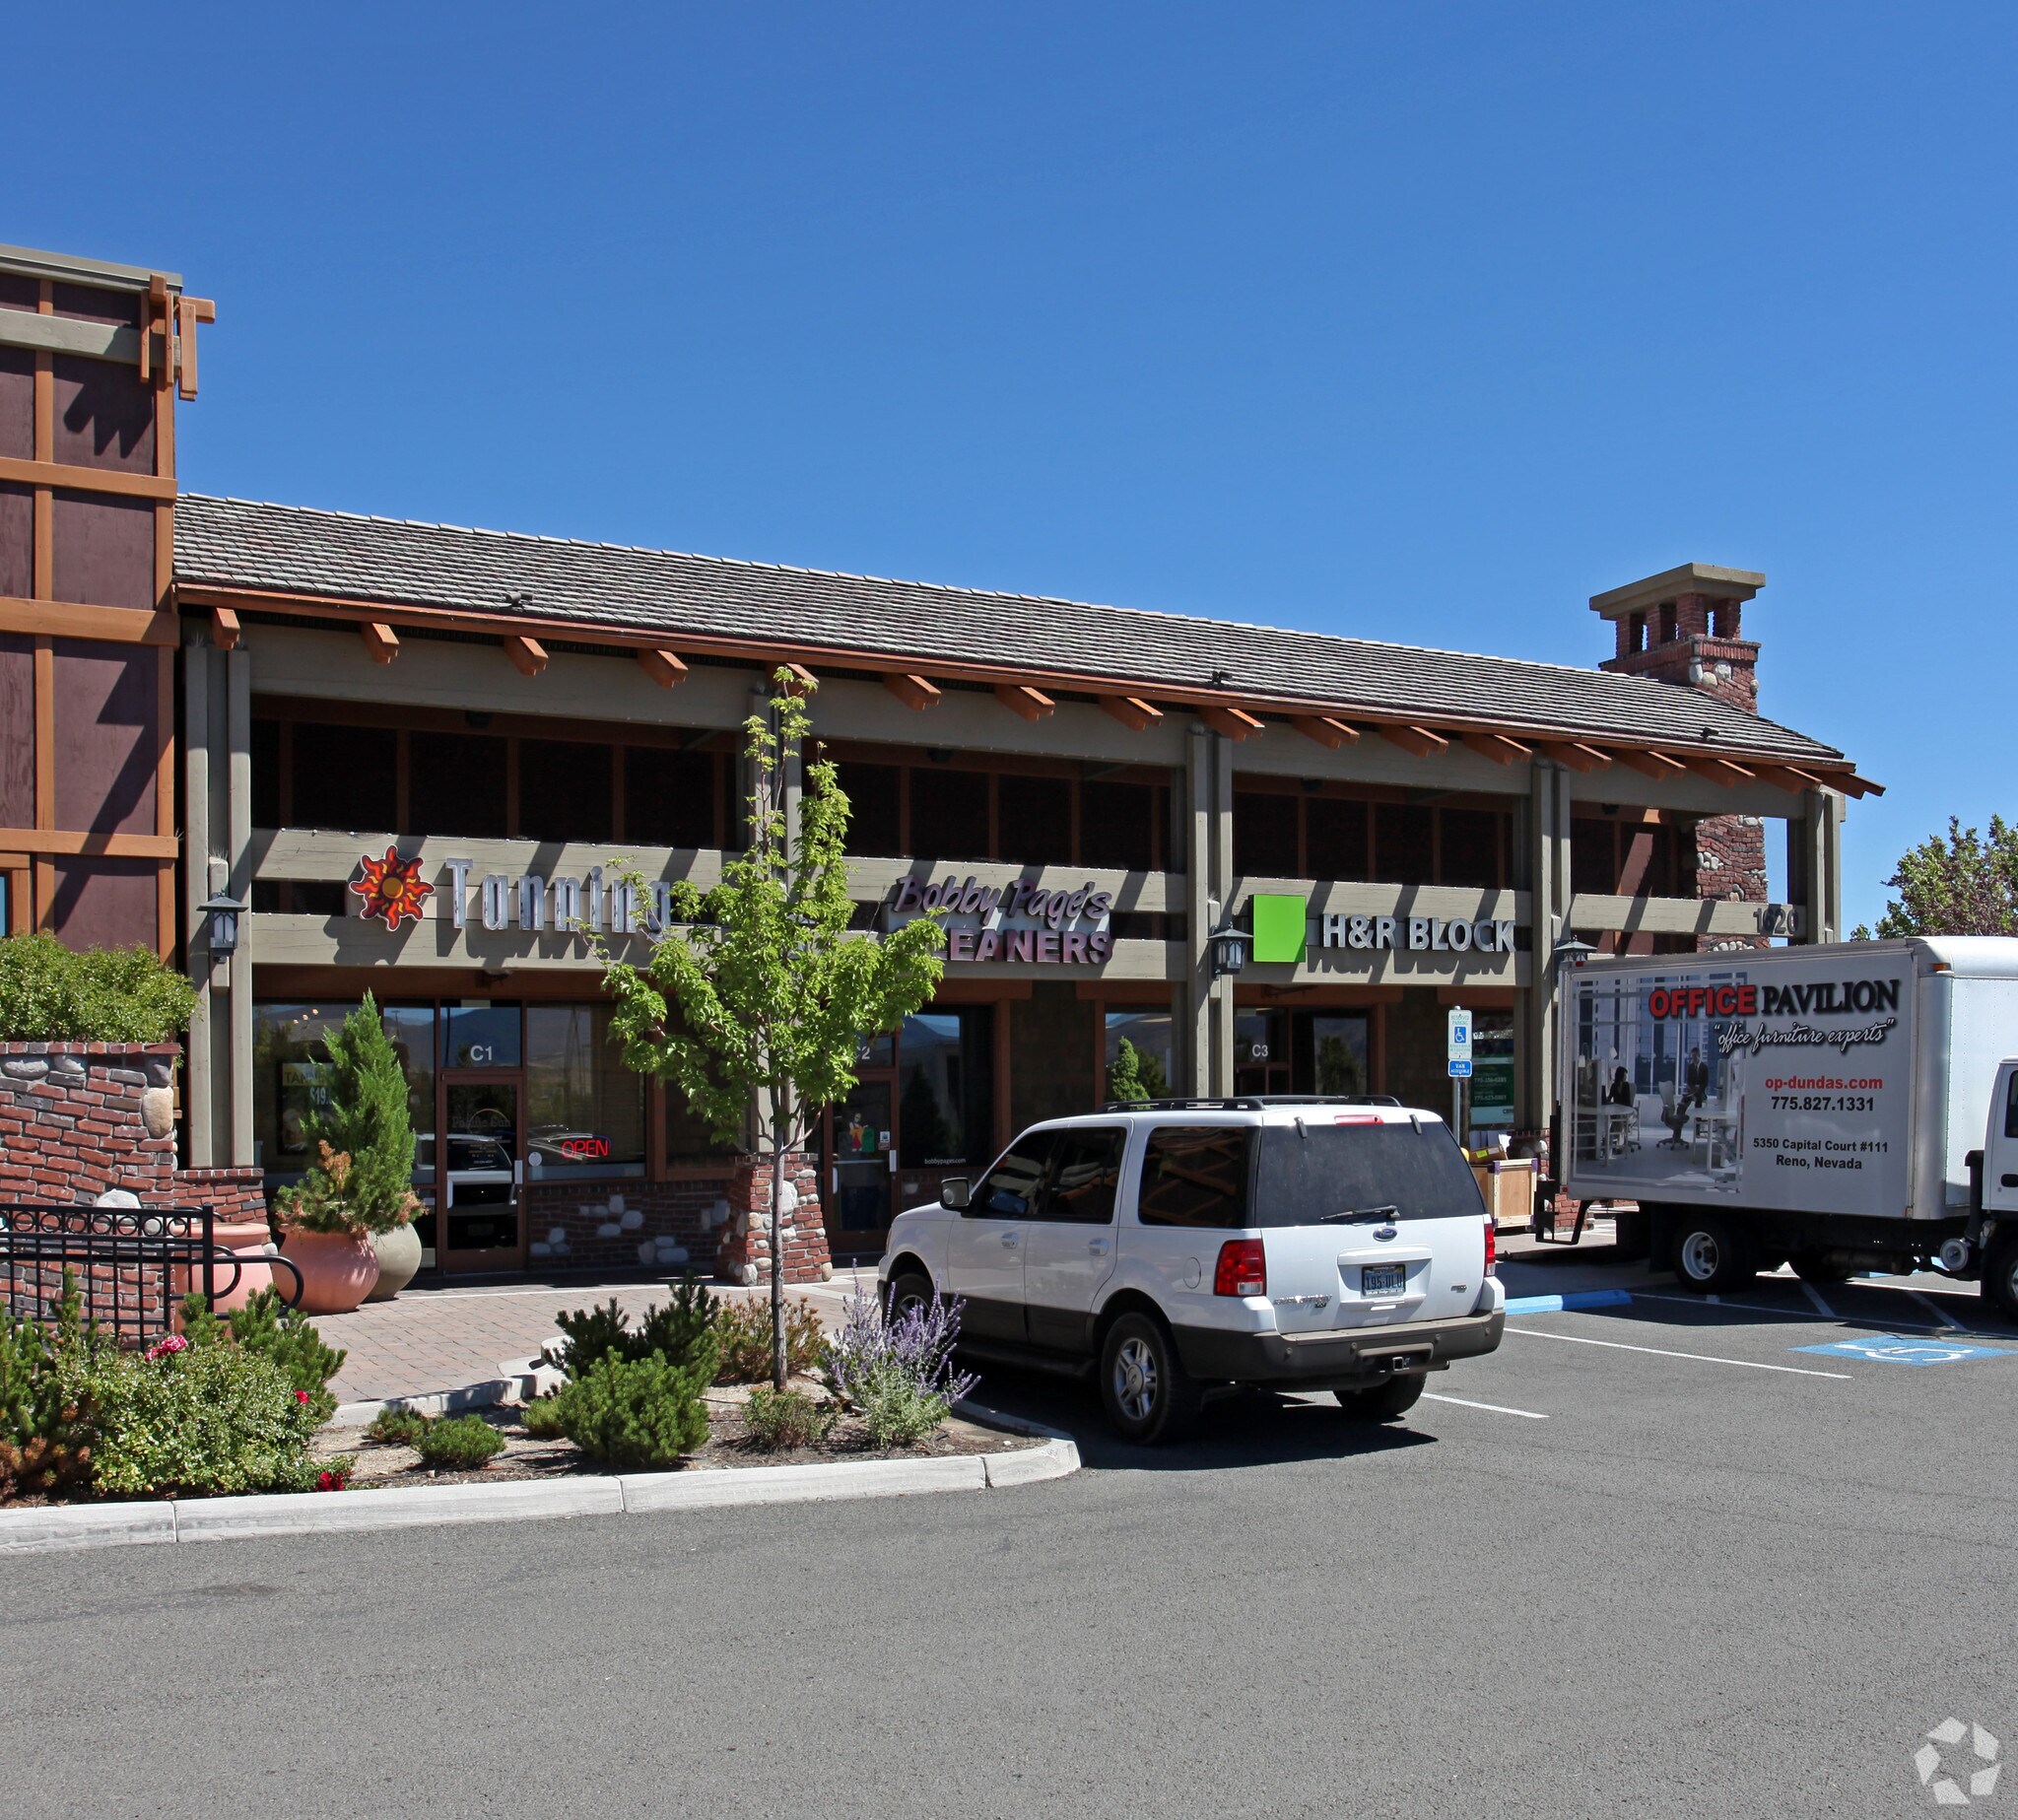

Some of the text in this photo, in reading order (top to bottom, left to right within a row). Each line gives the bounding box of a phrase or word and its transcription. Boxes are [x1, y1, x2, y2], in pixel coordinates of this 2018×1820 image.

[445, 857, 671, 942] Tanning
[893, 875, 1113, 930] Bobby Page's
[1753, 908, 1798, 934] 1620
[1321, 913, 1516, 952] H&R BLOCK
[932, 927, 1113, 964] EANERS
[1648, 978, 1901, 1018] OFFICE PAVILION
[1752, 1021, 1824, 1053] furniture
[470, 1045, 493, 1061] C1
[1251, 1044, 1268, 1056] C3
[1765, 1075, 1883, 1091] op-dundas.com
[1771, 1096, 1874, 1112] 775.827.1331
[562, 1139, 610, 1159] OPEN
[1753, 1137, 1889, 1153] 5350 Capital Court #111
[924, 1157, 967, 1166] bobbypages.com
[1776, 1154, 1863, 1170] Reno, Nevada
